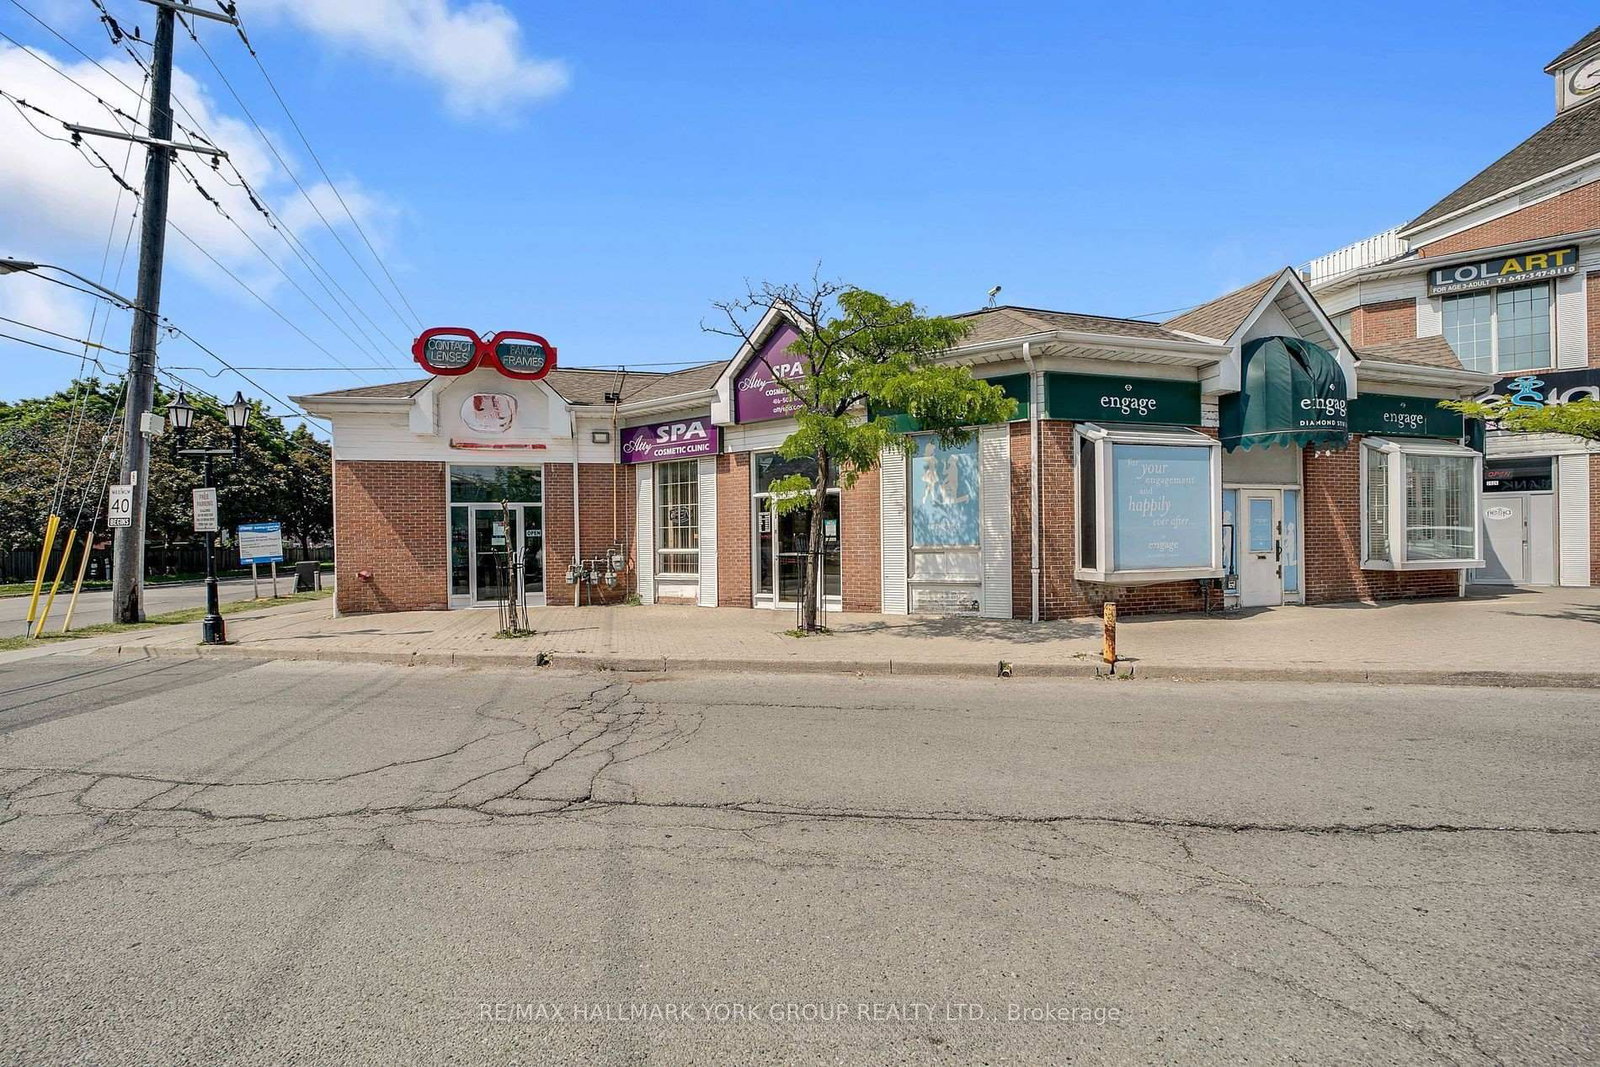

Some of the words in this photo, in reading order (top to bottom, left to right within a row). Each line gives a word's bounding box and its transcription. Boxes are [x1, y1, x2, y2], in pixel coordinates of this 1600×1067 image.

[1433, 286, 1447, 294] FOR
[428, 340, 471, 352] CONTACT
[431, 351, 469, 363] LENSES
[503, 355, 544, 367] FRAMES
[771, 361, 803, 380] SPA
[1100, 396, 1157, 416] engage
[1300, 398, 1347, 417] engag
[1383, 411, 1424, 429] engage
[656, 421, 708, 443] SPA
[654, 447, 686, 457] COSMETIC
[687, 443, 710, 454] CLINIC
[1136, 463, 1169, 480] your
[111, 499, 130, 513] 40
[1128, 495, 1172, 517] happily
[110, 518, 130, 526] BEGINS
